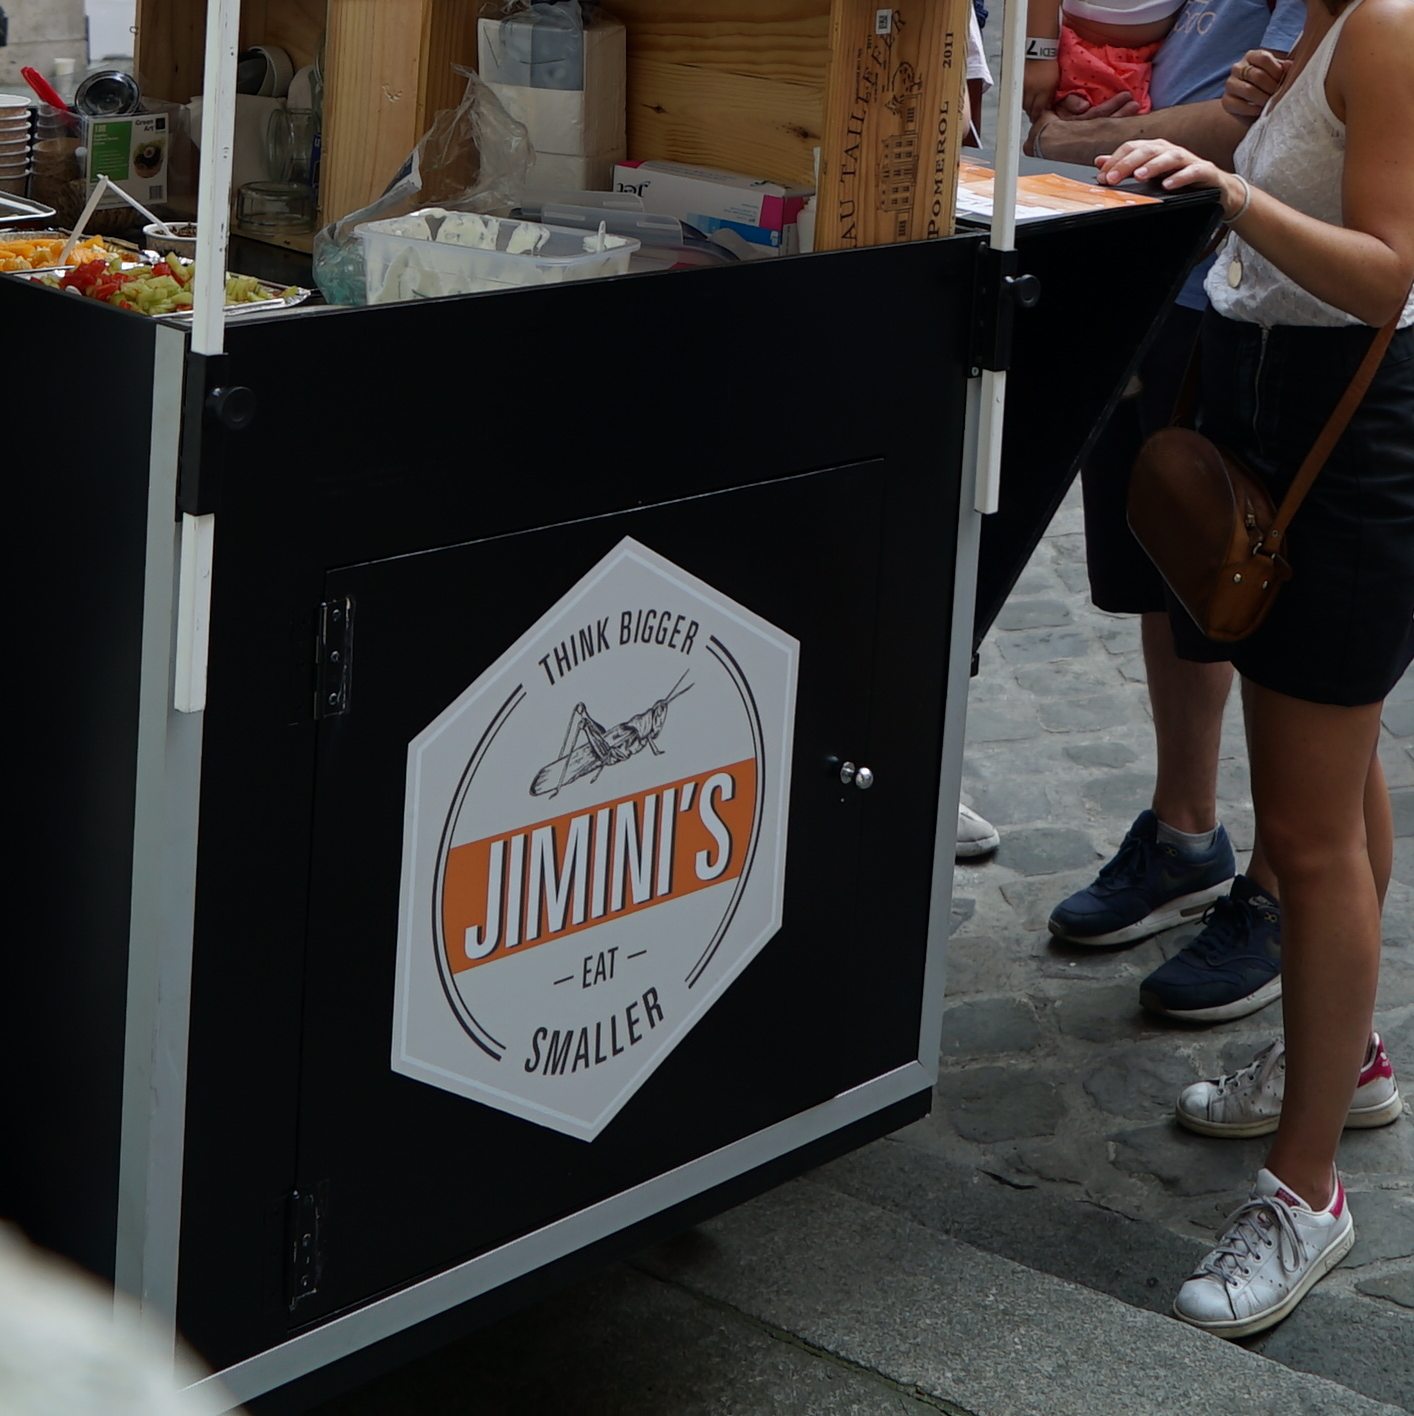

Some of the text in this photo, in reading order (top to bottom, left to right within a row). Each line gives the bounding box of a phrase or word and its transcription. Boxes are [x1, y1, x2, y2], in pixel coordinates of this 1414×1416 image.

[839, 10, 907, 184] TAILLEFER
[926, 32, 955, 240] POMEROL 2011
[537, 608, 700, 686] THINK BIGGER
[464, 771, 737, 962] JIMINI'S
[523, 986, 666, 1077] SMALLER
[581, 946, 620, 990] EAT
